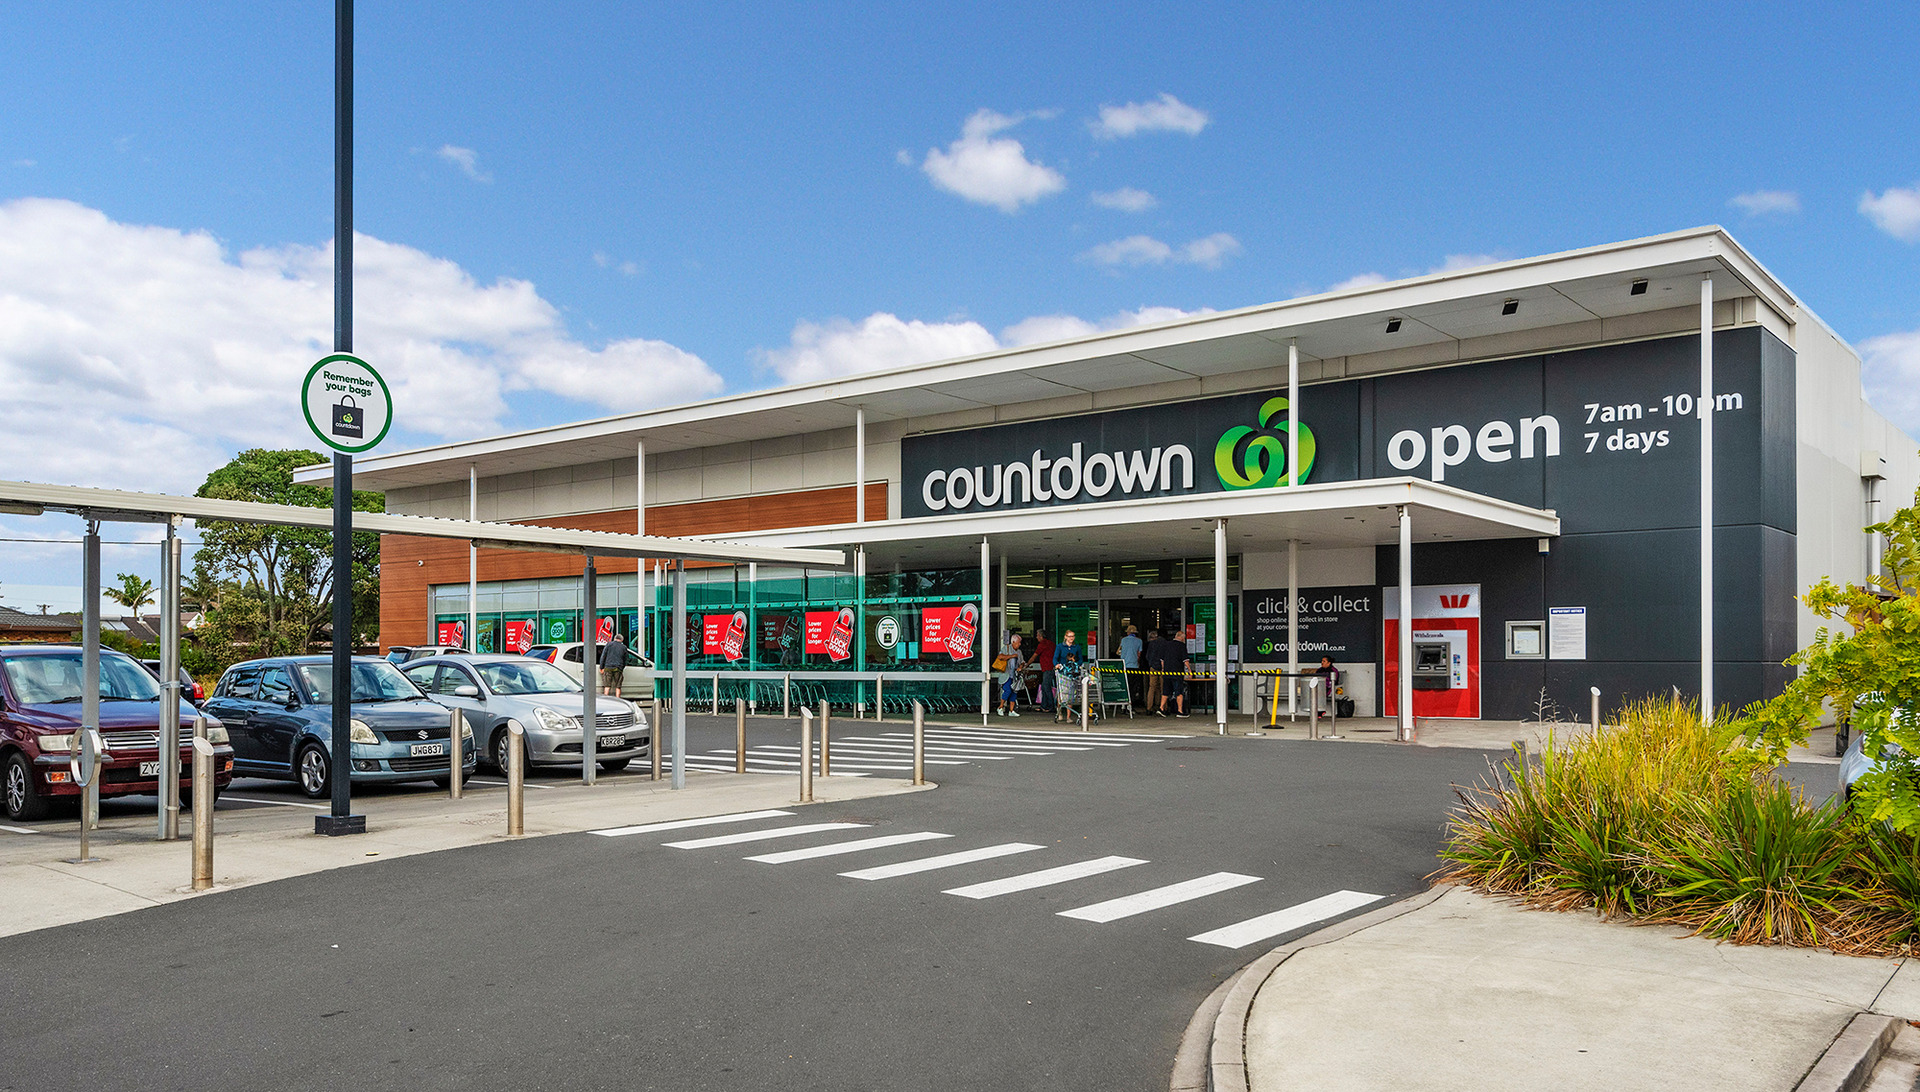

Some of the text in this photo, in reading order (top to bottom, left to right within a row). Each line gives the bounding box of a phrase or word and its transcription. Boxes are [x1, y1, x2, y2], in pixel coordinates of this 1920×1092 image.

[323, 370, 374, 387] Remember
[325, 382, 372, 397] your bags
[1584, 402, 1642, 424] 7am
[335, 422, 360, 430] countdown
[1387, 414, 1560, 482] open
[1584, 428, 1670, 454] 7 days
[922, 442, 1194, 511] countdown
[1256, 595, 1370, 614] click & collect
[833, 629, 849, 643] PRICE
[951, 633, 970, 649] LOCK
[954, 626, 972, 641] PRICE
[724, 644, 739, 657] DOWN
[726, 637, 740, 652] LOCK
[828, 643, 845, 656] DOWN
[831, 636, 848, 650] LOCK
[949, 640, 968, 656] DOWN
[1274, 640, 1346, 652] coutdown.co.nz
